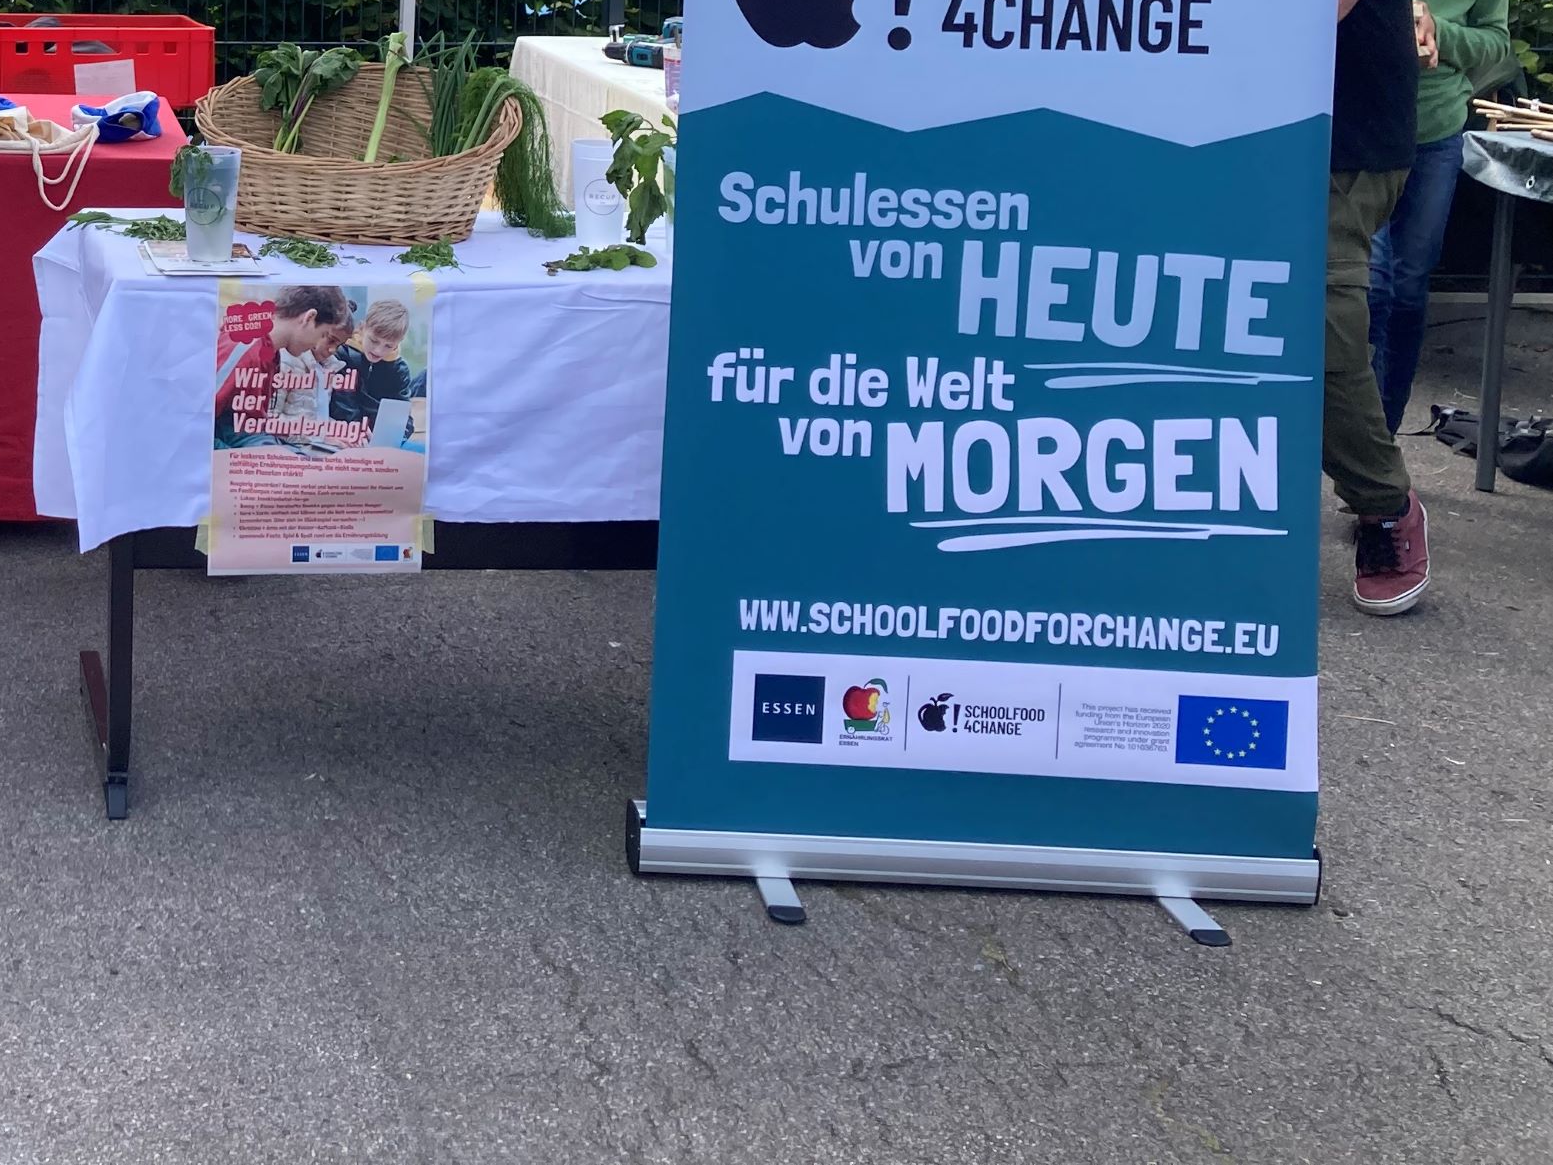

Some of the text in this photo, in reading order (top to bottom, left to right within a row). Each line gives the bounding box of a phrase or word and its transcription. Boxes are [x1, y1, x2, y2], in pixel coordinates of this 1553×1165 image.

[717, 171, 1030, 231] Schulessen
[849, 238, 1291, 357] von HEUTE
[223, 311, 273, 324] MORE GREEN
[223, 323, 244, 333] LESS
[234, 367, 358, 391] Wir sind Teil
[706, 347, 1016, 412] für die Welt
[231, 390, 266, 412] der
[232, 412, 369, 443] Veränderung!
[778, 416, 1279, 514] von MORGEN
[738, 598, 1280, 657] WWW.SCHOOLFOODFORCHANGE.EU
[761, 701, 817, 716] ESSEN
[964, 704, 1046, 723] SCHOOLFOOD
[1075, 710, 1103, 720] funding
[1104, 711, 1121, 719] from
[1135, 713, 1172, 723] European
[1082, 703, 1172, 715] This project has received
[963, 720, 1023, 736] 4CHANGE
[1084, 726, 1170, 737] research and innovation
[1122, 720, 1151, 728] Horizon
[1074, 740, 1113, 749] agreement
[1114, 742, 1126, 750] No
[1083, 734, 1170, 746] programme under grant
